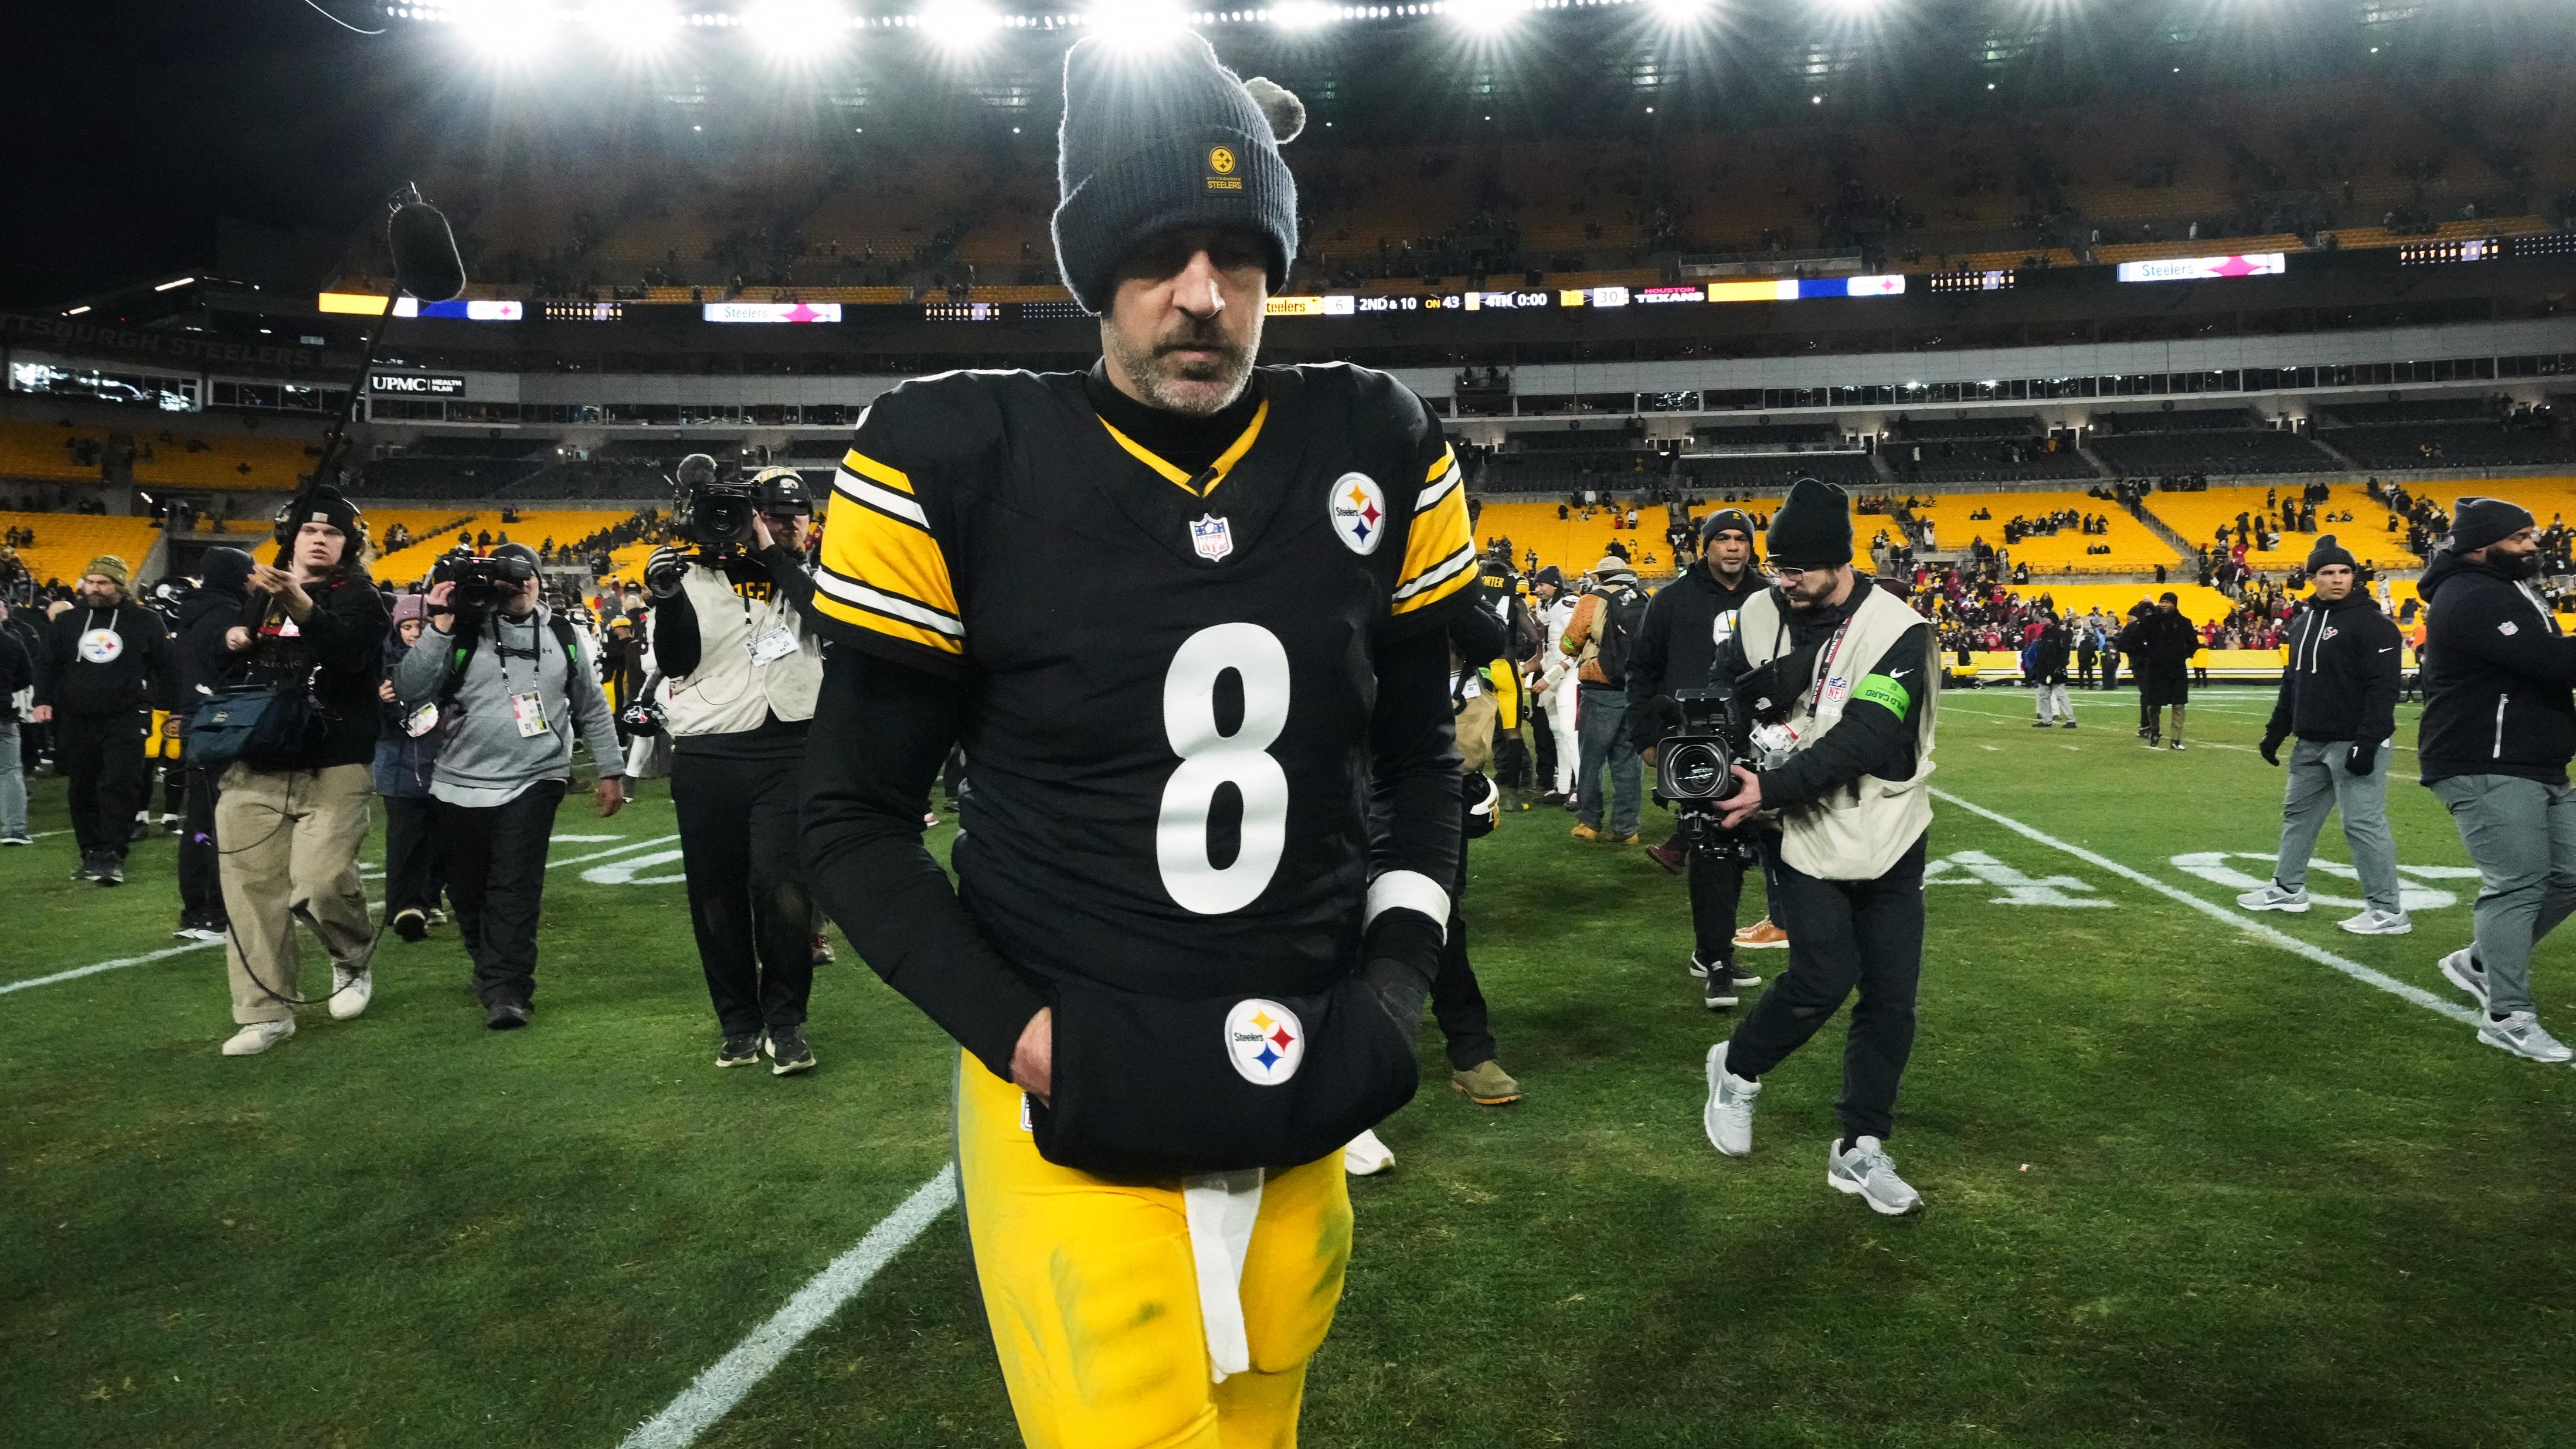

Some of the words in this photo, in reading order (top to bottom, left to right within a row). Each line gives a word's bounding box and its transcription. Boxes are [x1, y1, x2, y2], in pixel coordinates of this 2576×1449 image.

[1208, 181, 1242, 189] STEELERS
[2142, 264, 2194, 277] Steelers
[1485, 294, 1513, 307] 4TH
[1517, 293, 1547, 306] 0:00
[1599, 291, 1617, 302] 30
[1634, 292, 1704, 303] TEXANS
[1335, 299, 1343, 310] 6
[1360, 298, 1388, 311] 2ND
[1389, 300, 1398, 309] &
[1401, 297, 1417, 309] 10
[1425, 299, 1440, 308] ON
[1442, 296, 1460, 308] 43
[725, 307, 767, 318] Steelers
[169, 337, 311, 366] STEELERS
[372, 376, 426, 391] UPMC
[1336, 507, 1358, 516] Steelers
[1824, 638, 1839, 664] TEXANS
[1828, 687, 1844, 700] NFL
[1866, 689, 1889, 702] CARD
[1156, 622, 1290, 915] 8
[1234, 1032, 1264, 1042] Steelers
